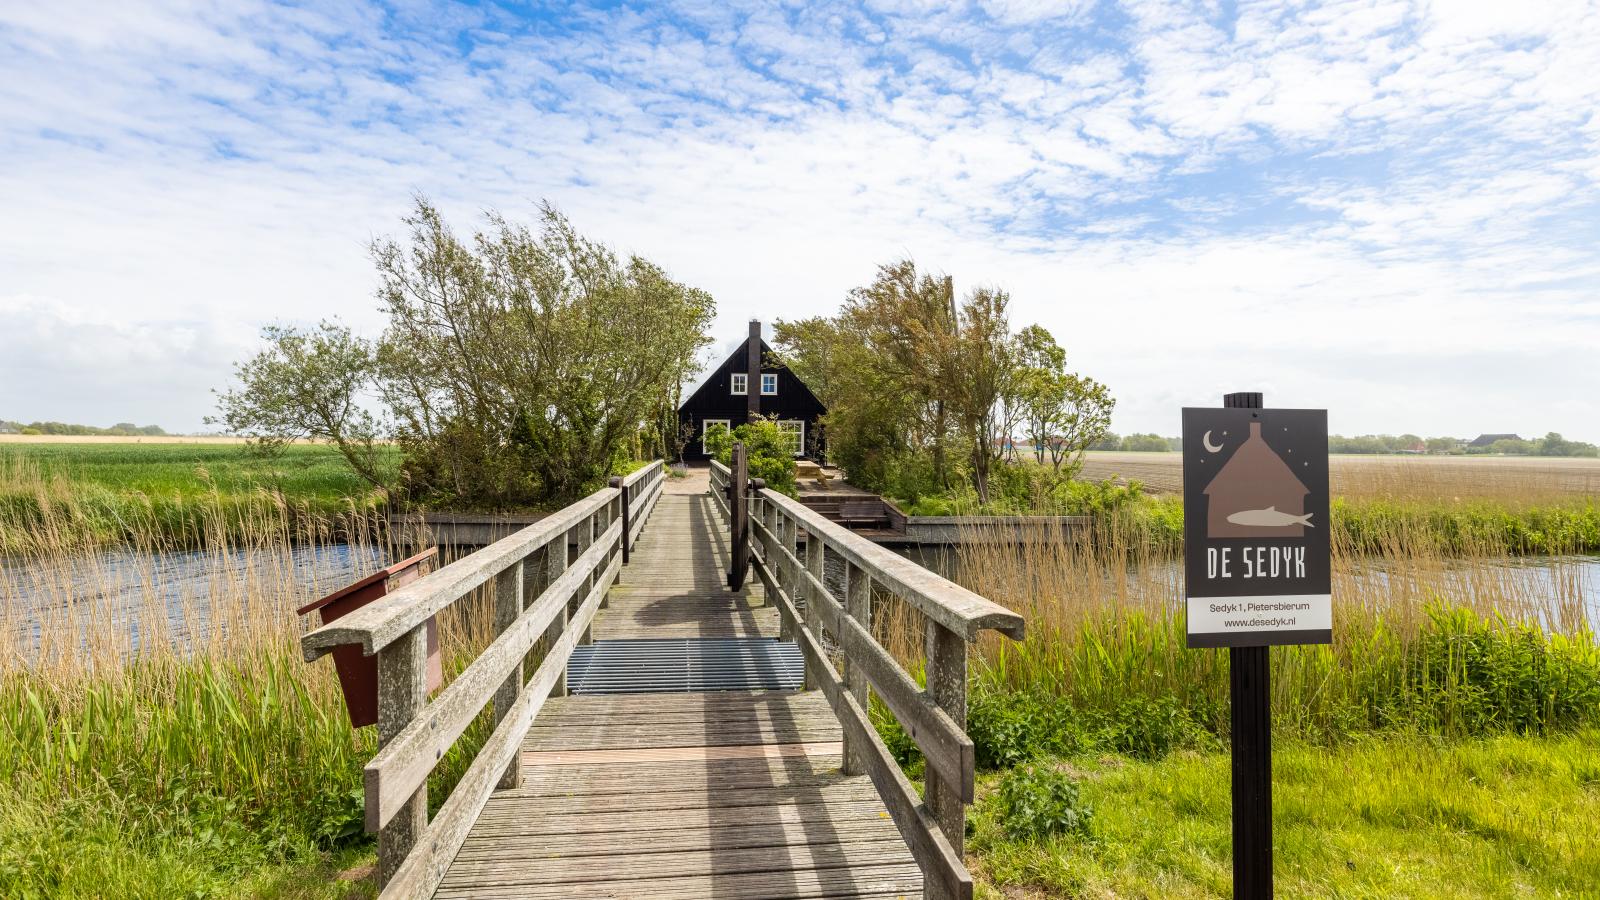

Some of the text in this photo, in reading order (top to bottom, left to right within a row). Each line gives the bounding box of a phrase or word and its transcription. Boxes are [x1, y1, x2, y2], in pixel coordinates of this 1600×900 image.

[1207, 546, 1306, 579] DE SEDYK
[1209, 603, 1237, 614] Sedyk
[1247, 602, 1310, 612] Pietersbierum
[1224, 617, 1296, 628] www.desedyk.nl
